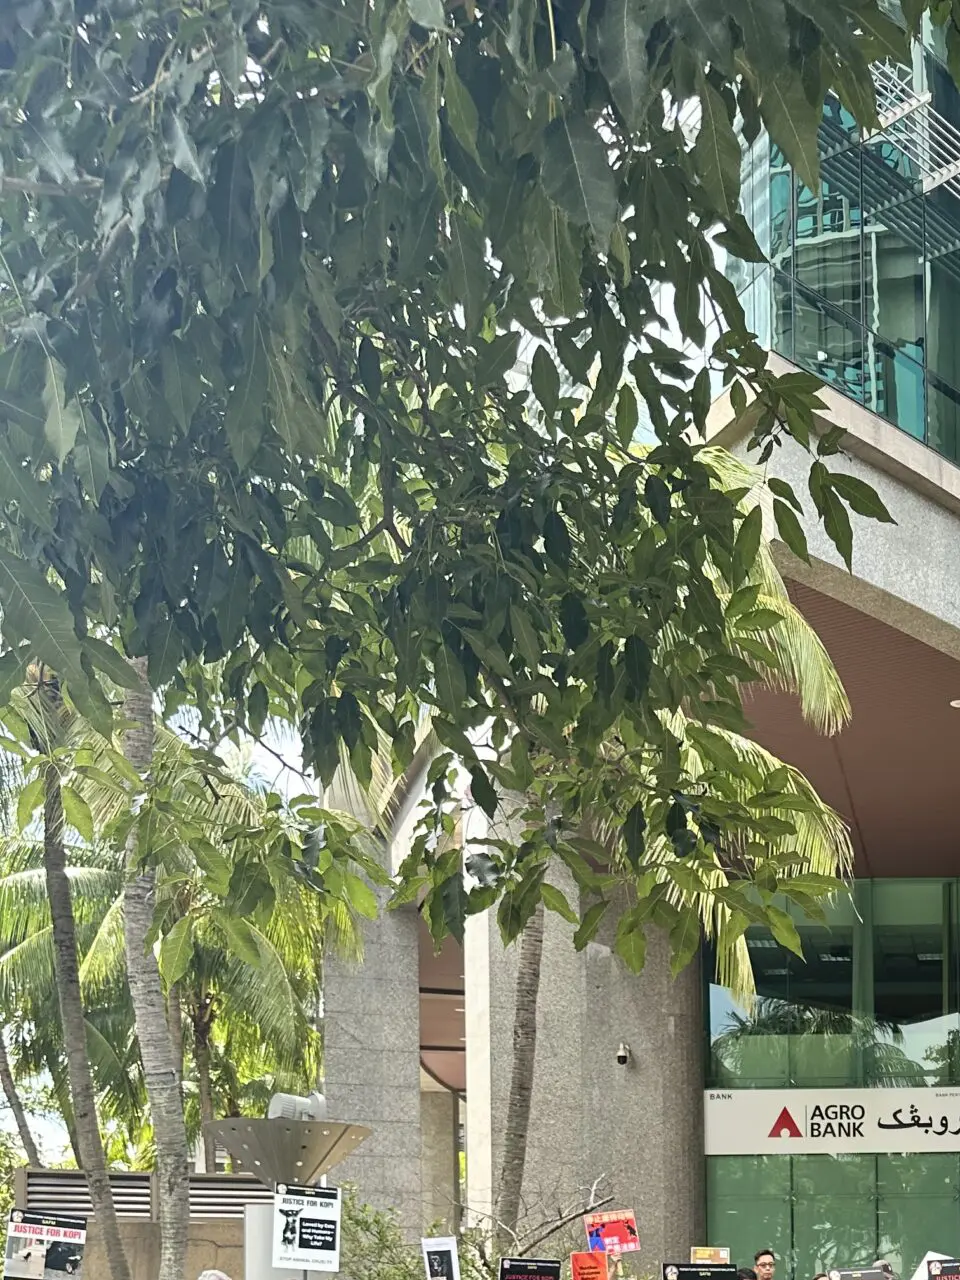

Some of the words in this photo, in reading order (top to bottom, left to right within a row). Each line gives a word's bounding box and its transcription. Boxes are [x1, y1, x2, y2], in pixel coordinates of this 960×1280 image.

[810, 1104, 865, 1120] AGRO
[811, 1122, 864, 1138] BANK
[282, 1197, 304, 1206] JUSTICE
[13, 1224, 44, 1235] JUSTICE
[46, 1228, 61, 1237] FOR
[63, 1230, 82, 1240] KOPI
